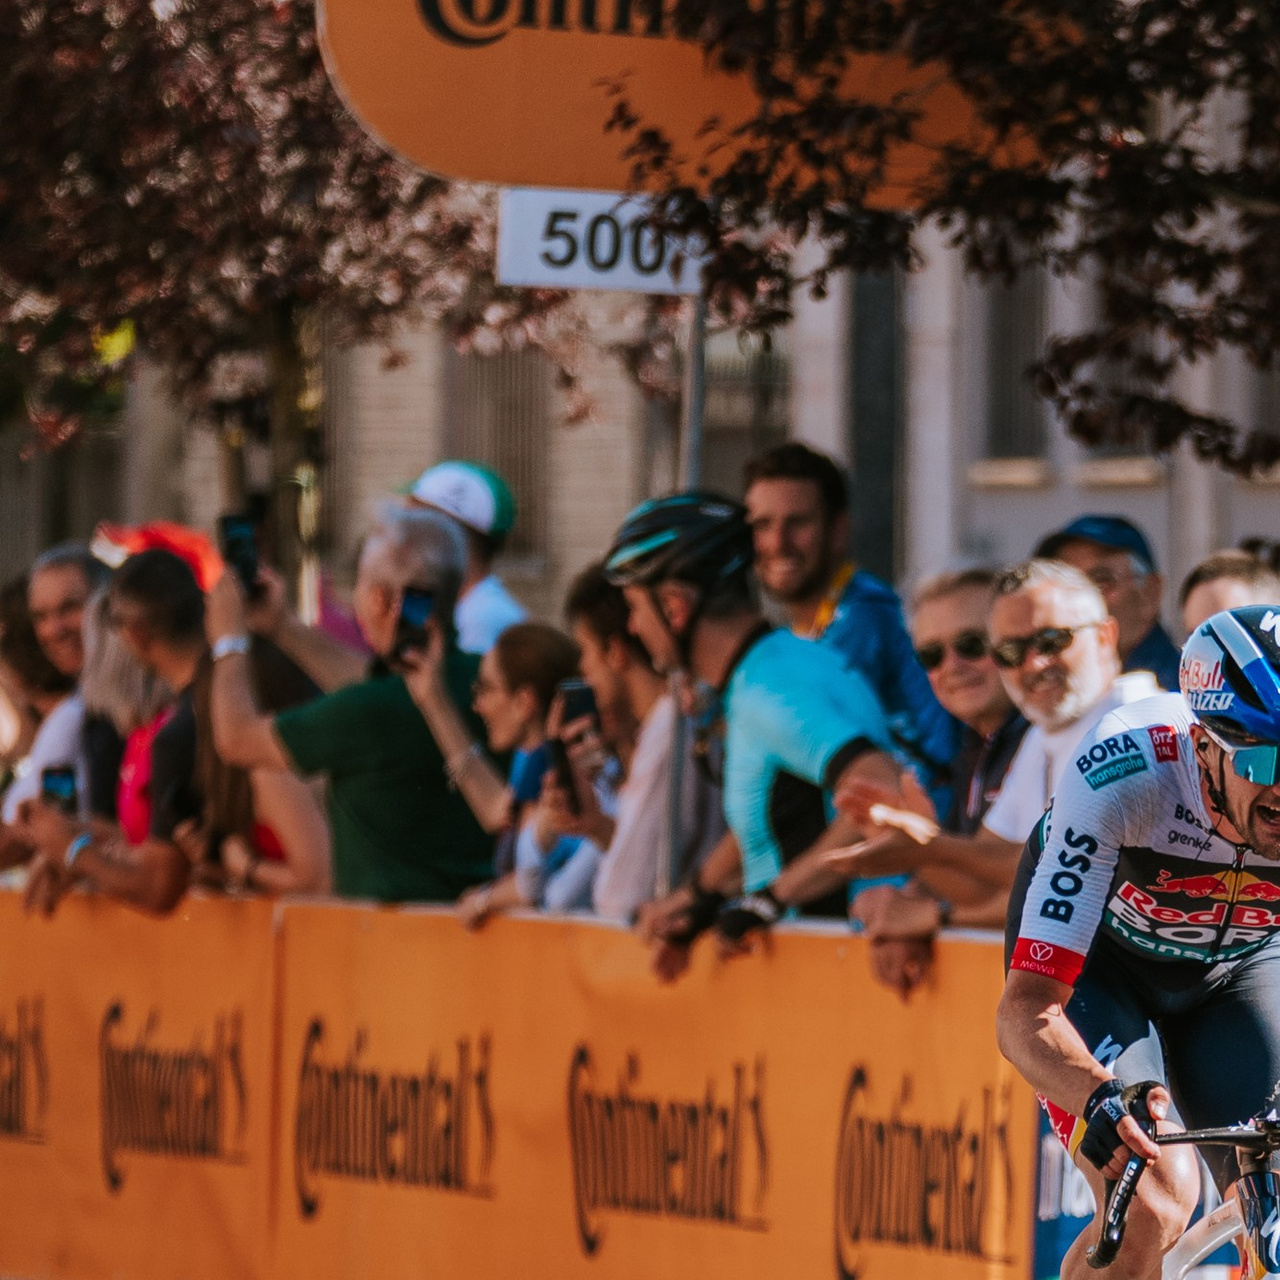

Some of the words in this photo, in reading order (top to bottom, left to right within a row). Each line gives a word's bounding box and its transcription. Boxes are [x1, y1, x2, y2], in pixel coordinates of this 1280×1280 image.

[541, 211, 669, 276] 500
[1076, 734, 1141, 775] BORA
[1089, 756, 1145, 787] hansgrohe
[1168, 829, 1212, 852] grenke
[1040, 827, 1098, 924] BOSS
[1107, 896, 1270, 946] BOR
[1117, 881, 1228, 925] Red
